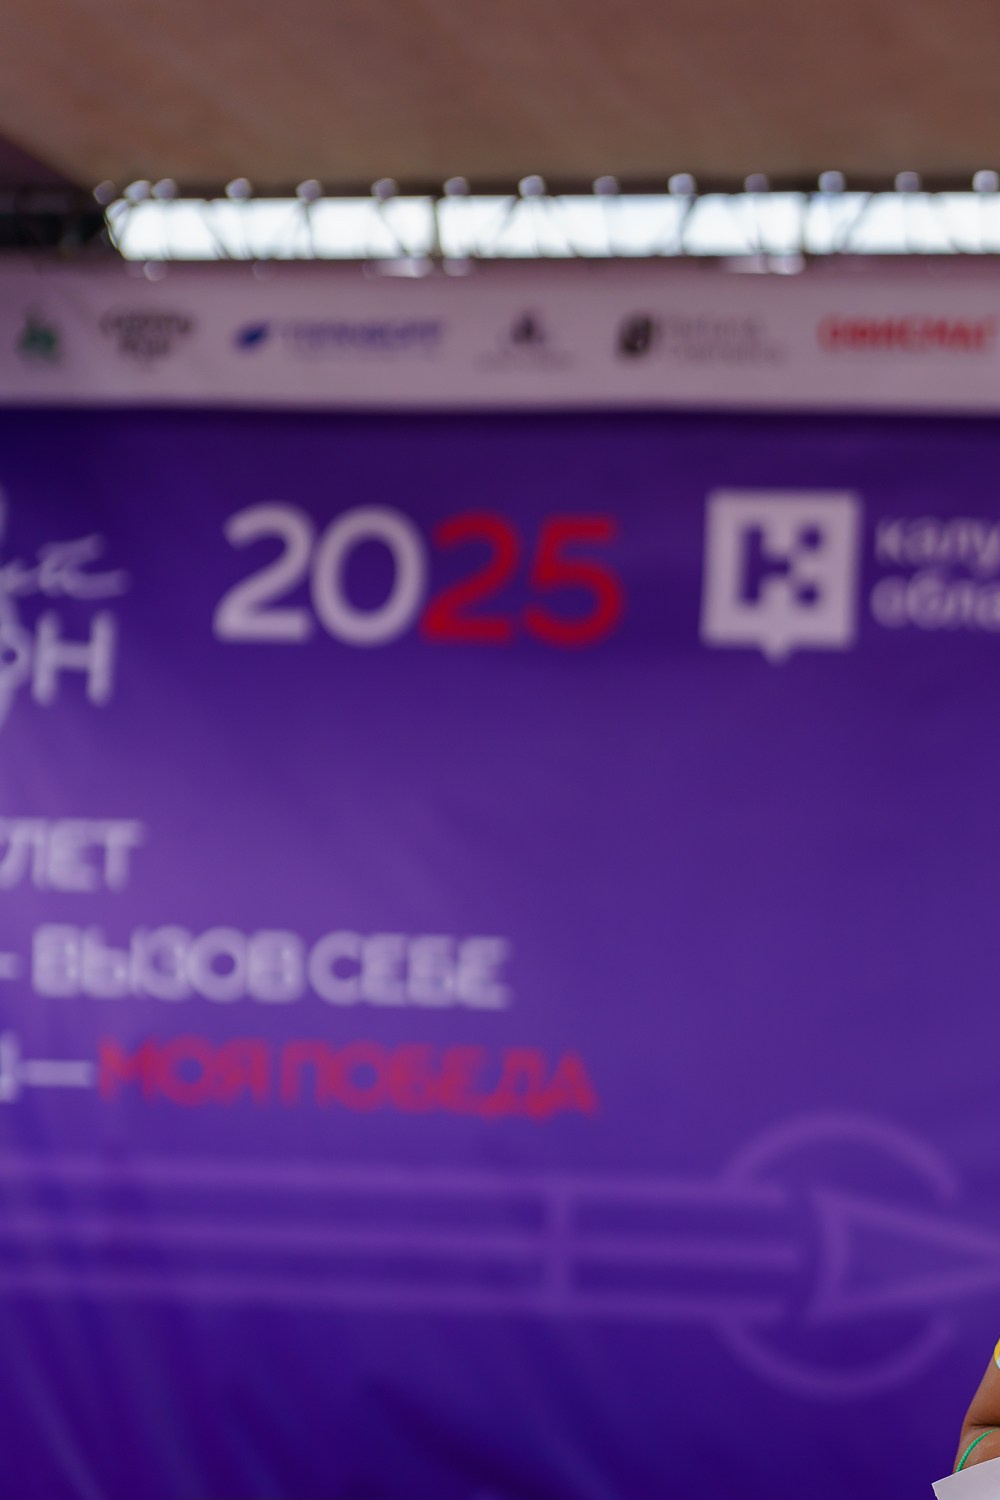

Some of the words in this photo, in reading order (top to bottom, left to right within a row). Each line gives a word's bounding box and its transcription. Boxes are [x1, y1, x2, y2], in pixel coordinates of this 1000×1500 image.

[211, 502, 626, 648] 2025
[32, 924, 303, 1001] ВЫЗОВ
[308, 931, 511, 1009] СЕБЕ
[100, 1034, 271, 1107] МОЯ
[281, 1039, 599, 1123] ПОБЕДА
